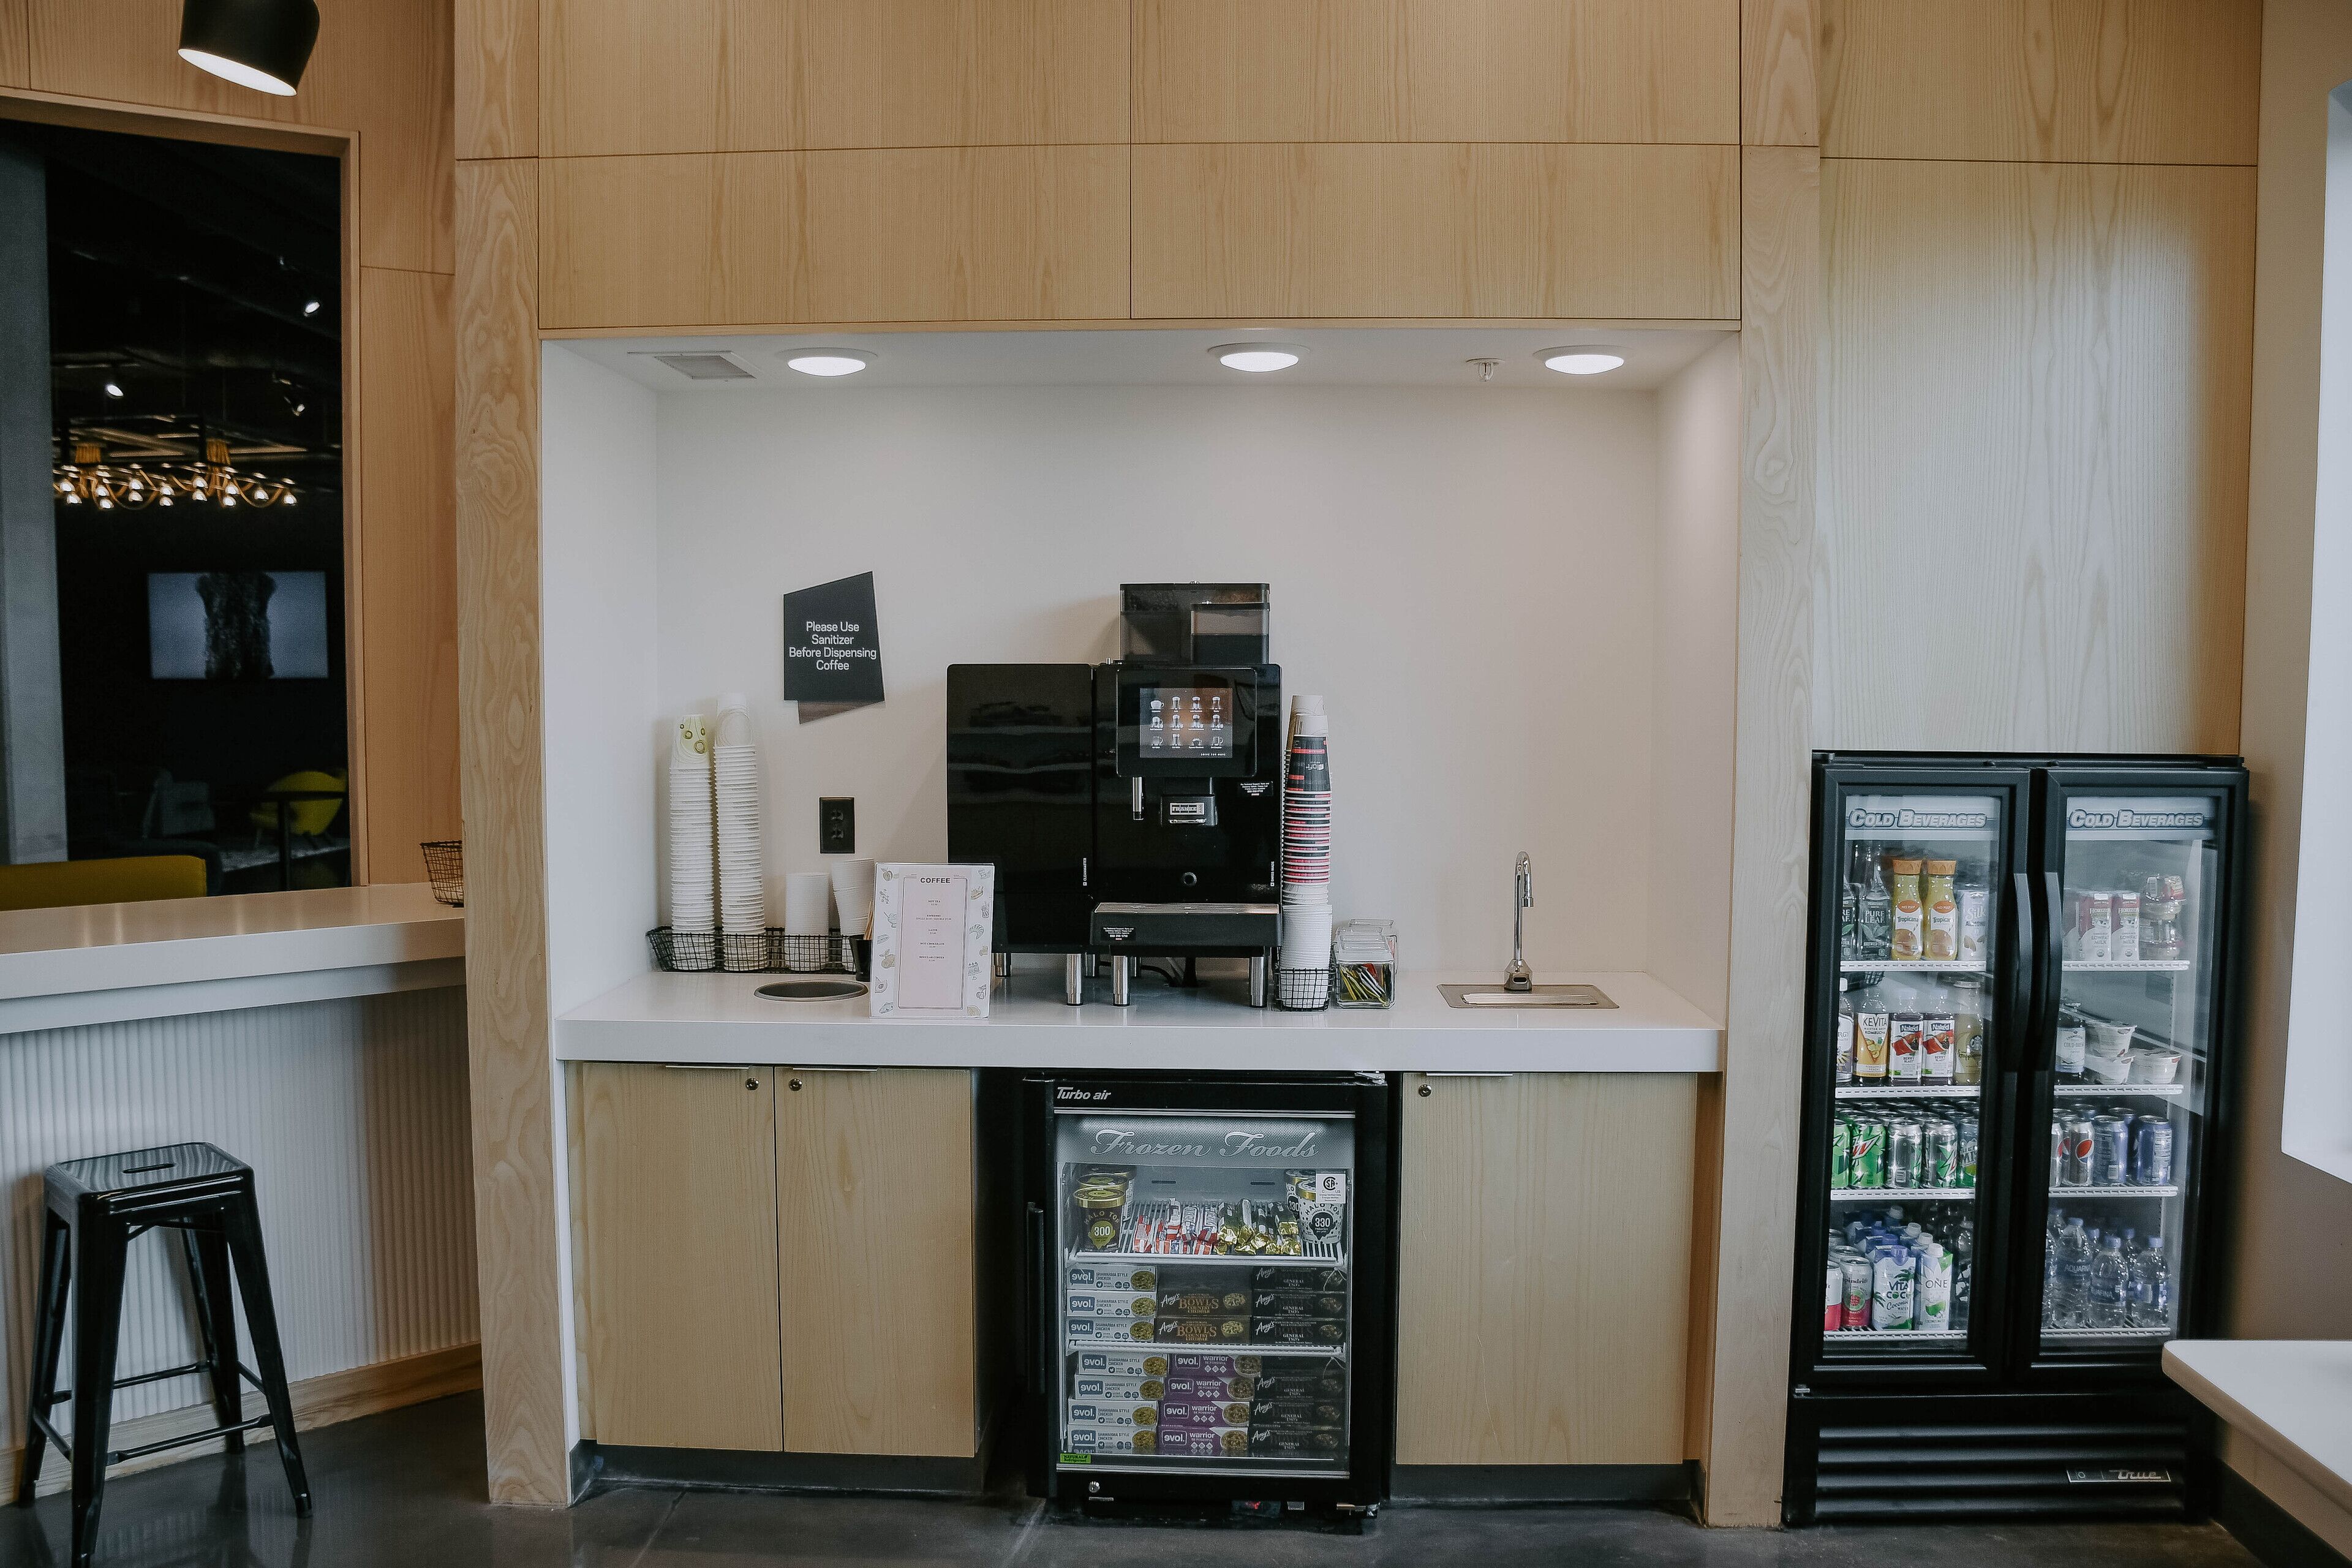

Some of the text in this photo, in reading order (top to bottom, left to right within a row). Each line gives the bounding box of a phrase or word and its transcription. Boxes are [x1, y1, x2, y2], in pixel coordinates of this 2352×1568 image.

[806, 621, 859, 631] Please Use
[812, 634, 854, 644] Sanitizer
[789, 647, 876, 660] Before Dispensing
[816, 660, 850, 670] Coffee
[1849, 809, 1986, 828] COLD BEVERAGES
[2070, 809, 2204, 828] COLD BEVERAGES
[1863, 1017, 1887, 1027] KEVITA
[1057, 1087, 1112, 1100] Turbo air
[1090, 1129, 1319, 1158] Frozen Foods
[1289, 1200, 1299, 1212] 330
[1305, 1204, 1340, 1216] HALO TOP
[1084, 1211, 1119, 1225] HALO TOP
[1315, 1218, 1330, 1227] 330
[1095, 1226, 1110, 1236] 300
[1256, 1267, 1275, 1281] Amy's
[1889, 1281, 1909, 1291] VITA
[1926, 1280, 1948, 1289] ONE
[1161, 1293, 1180, 1308] Amy's
[1178, 1298, 1219, 1309] BOWLS
[1256, 1294, 1275, 1307] Amy's
[1159, 1321, 1178, 1335] Amy's
[1177, 1326, 1217, 1337] BOWLS
[1256, 1321, 1275, 1335] Amy's
[1084, 1358, 1105, 1366] evol.
[1178, 1357, 1199, 1365] evol.
[1081, 1383, 1102, 1392] evol.
[1257, 1377, 1276, 1390] Amy's
[1254, 1402, 1273, 1415] Amy's
[1074, 1433, 1095, 1441] evol.
[1252, 1430, 1270, 1443] Amy's
